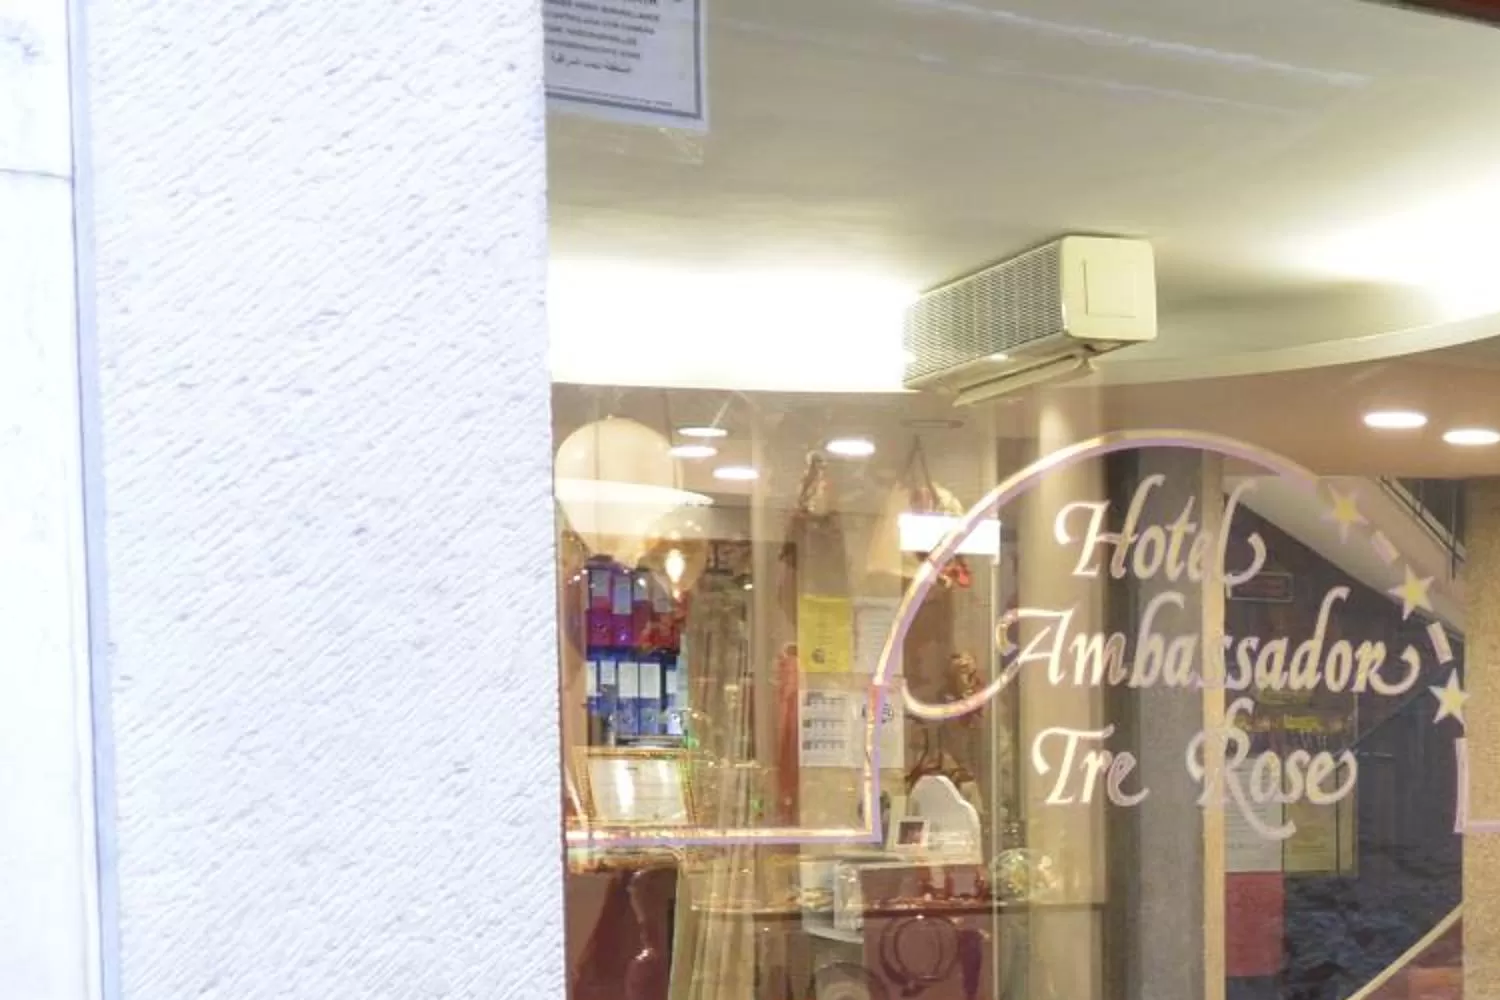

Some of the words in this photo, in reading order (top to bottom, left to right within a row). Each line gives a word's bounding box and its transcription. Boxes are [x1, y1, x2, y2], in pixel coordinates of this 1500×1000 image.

[1055, 474, 1267, 588] Hotel
[996, 586, 1421, 698] Ambassador
[1032, 725, 1150, 807] Tre
[1186, 698, 1358, 839] Rose
